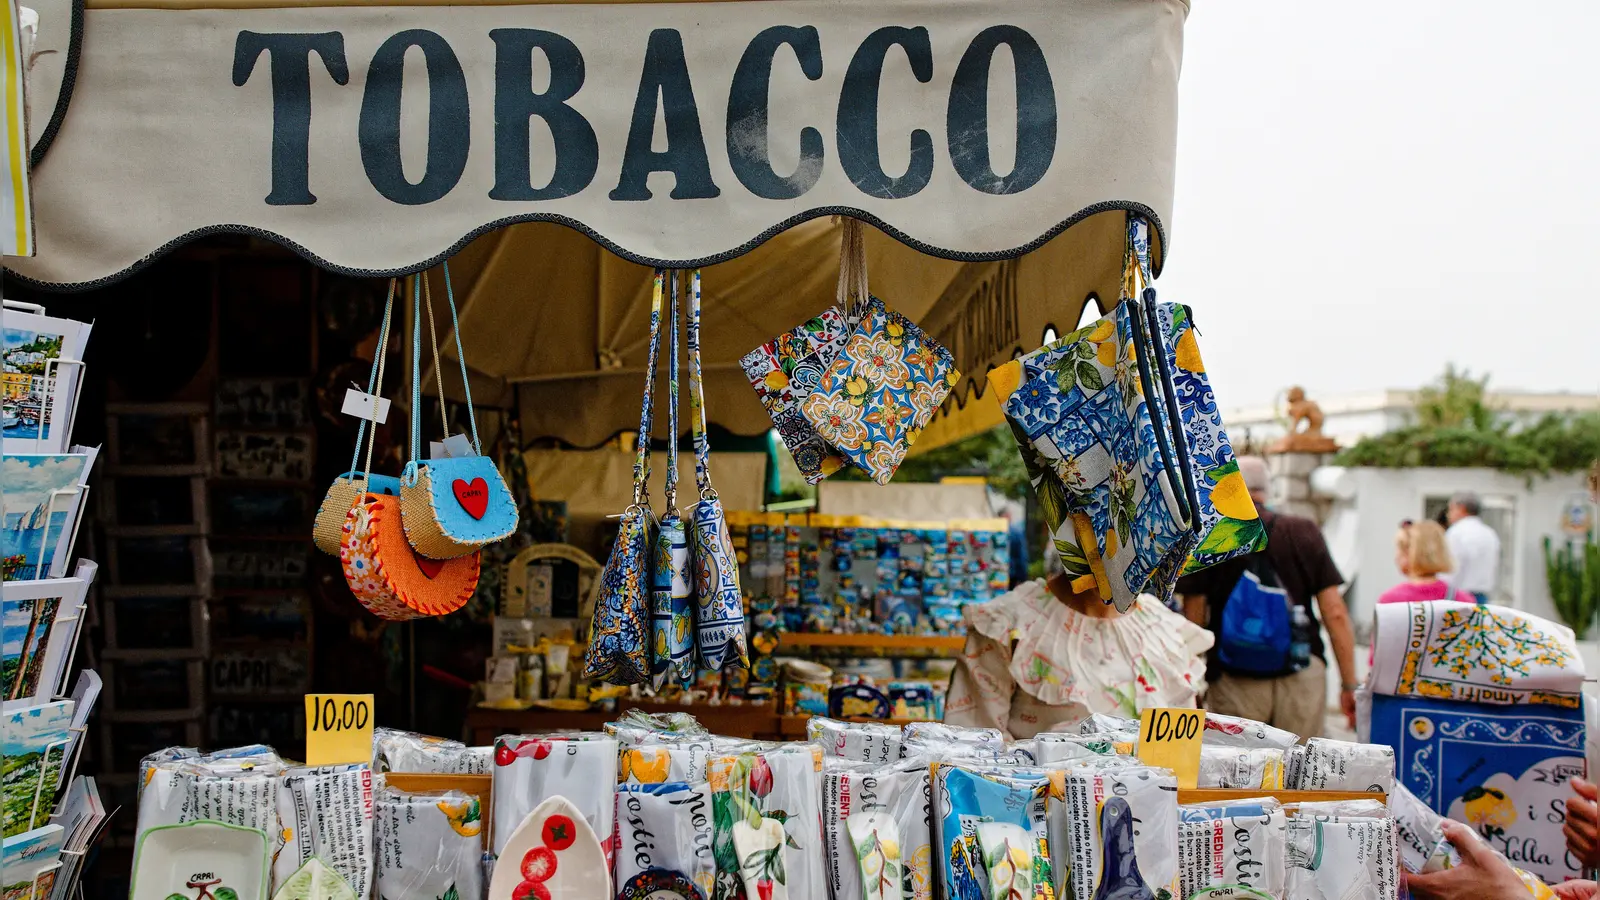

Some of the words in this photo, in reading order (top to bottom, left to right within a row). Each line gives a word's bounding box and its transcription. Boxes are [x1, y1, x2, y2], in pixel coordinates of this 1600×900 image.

[233, 25, 1058, 205] TOBACCO
[461, 489, 482, 498] CAPRI
[213, 660, 272, 688] CAPRI
[1459, 686, 1525, 705] Amalfi
[313, 697, 369, 733] 10,00
[1146, 708, 1199, 742] 10,00
[324, 783, 332, 808] arancia
[333, 774, 342, 795] burro
[341, 774, 352, 810] cioccolato
[351, 773, 362, 805] mandorle
[361, 769, 373, 820] EDIENTI
[829, 775, 838, 806] mandorle
[315, 800, 324, 812] per
[840, 774, 851, 820] EDIENTI
[1071, 785, 1081, 821] cioccolato
[1080, 785, 1090, 817] mandorle
[294, 790, 307, 828] DELIZIA
[353, 806, 364, 828] pelate
[829, 806, 838, 827] pelate
[1528, 804, 1537, 821] i
[327, 820, 337, 853] cucchiaio
[336, 825, 346, 847] medie
[345, 810, 355, 842] fondente
[1082, 819, 1092, 841] pelate
[356, 835, 366, 856] farina
[829, 831, 839, 850] farina
[1074, 822, 1083, 853] fondente
[1187, 838, 1195, 857] burro
[20, 842, 50, 860] Capri
[1077, 854, 1084, 862] di
[1085, 848, 1095, 868] farina
[1178, 845, 1186, 869] arancia
[1196, 838, 1204, 871] cioccolato
[1204, 837, 1212, 867] mandorle
[348, 852, 358, 874] ottima
[1077, 863, 1085, 885] ottima
[1087, 869, 1095, 877] di
[1376, 867, 1384, 879] the
[833, 860, 842, 891] mandorle
[1203, 867, 1212, 887] pelate
[1209, 888, 1233, 899] CAPRI
